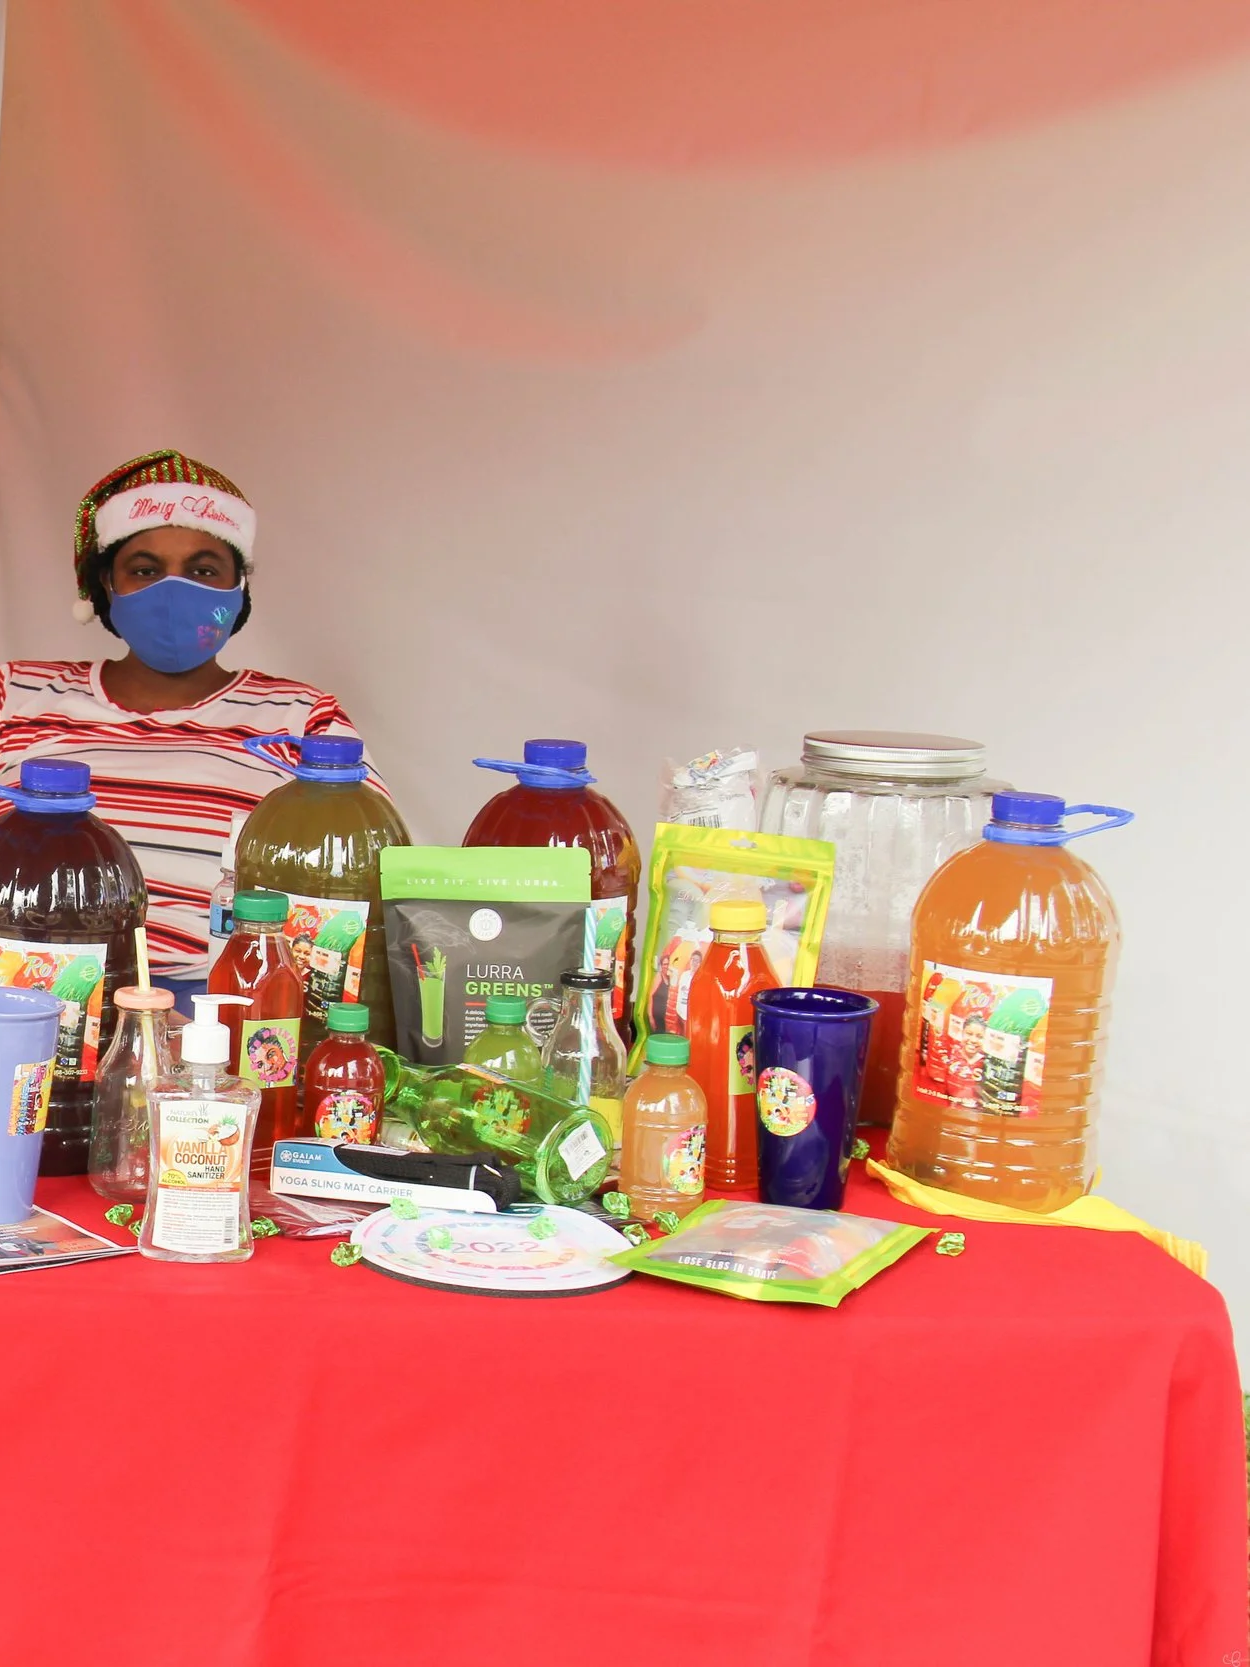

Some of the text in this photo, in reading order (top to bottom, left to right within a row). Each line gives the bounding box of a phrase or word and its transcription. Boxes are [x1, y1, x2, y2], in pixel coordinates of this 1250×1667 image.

[406, 878, 436, 886] LIVE
[465, 963, 525, 980] LURRA
[166, 1116, 209, 1124] COLLECTION
[176, 1140, 228, 1155] VANILLA
[174, 1152, 228, 1166] COCONUT
[292, 1152, 322, 1161] GAIAM
[187, 1172, 225, 1180] SANITIZER
[279, 1175, 413, 1198] YOGA SLING MAT CARRIER
[452, 1240, 547, 1254] 2022
[678, 1255, 779, 1281] LOSE 5LBS IN 5DAYS
